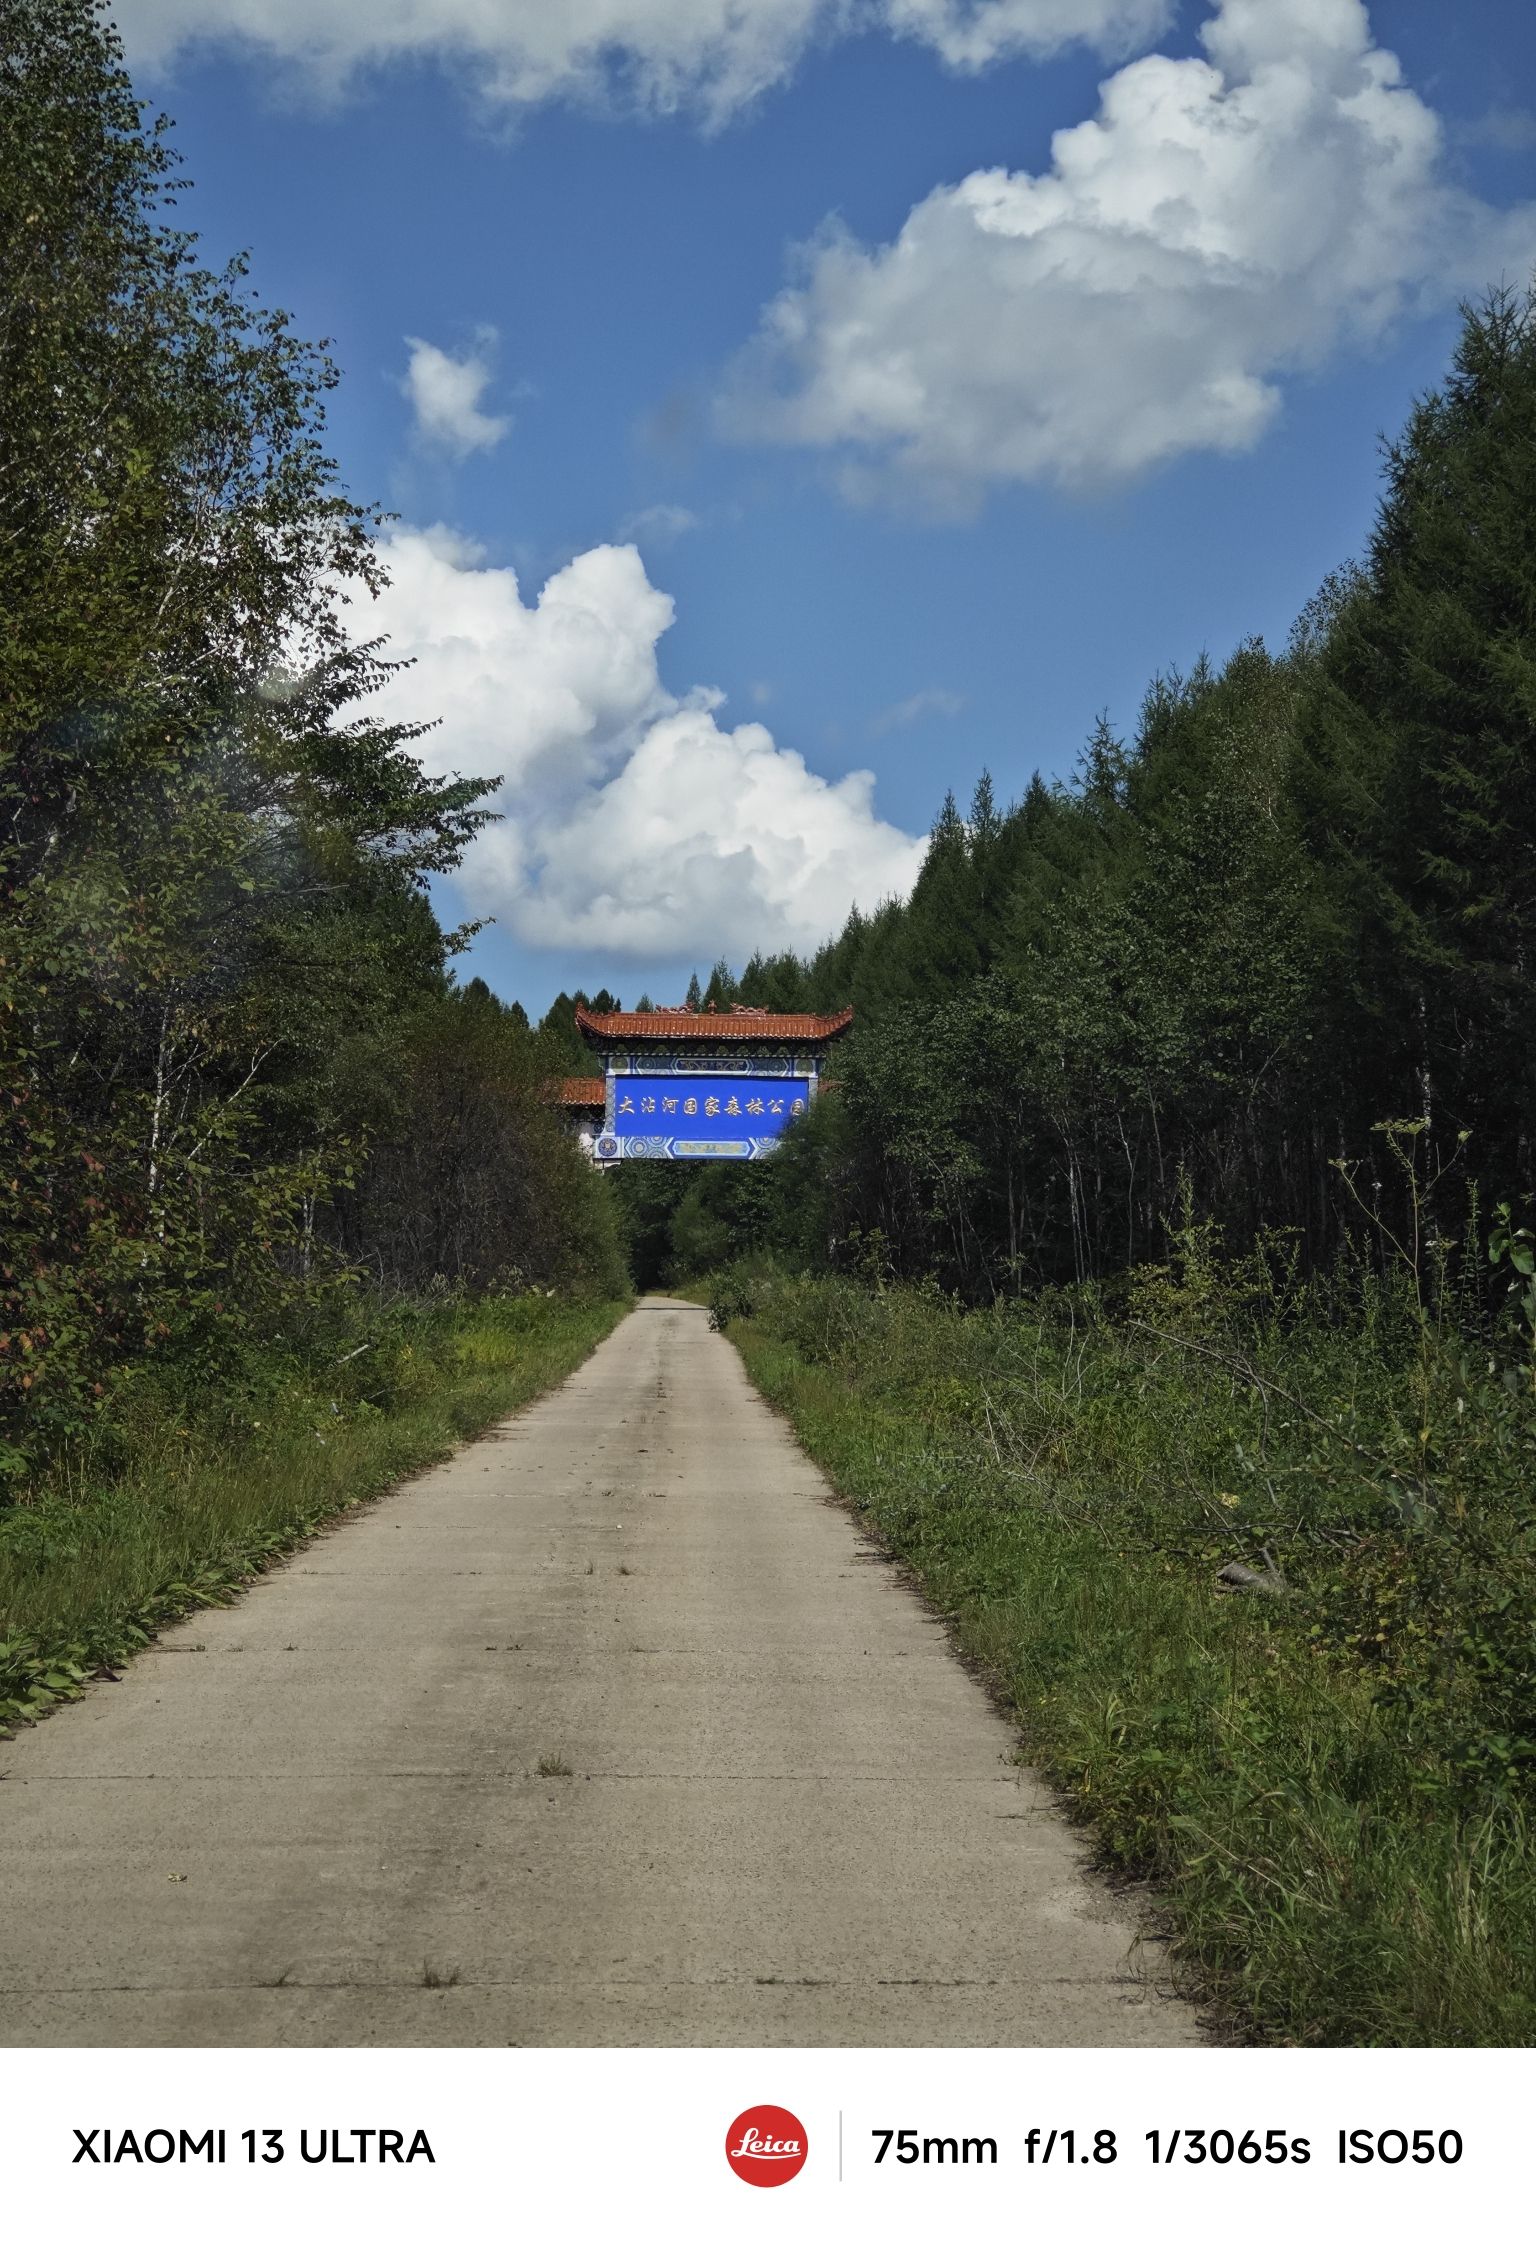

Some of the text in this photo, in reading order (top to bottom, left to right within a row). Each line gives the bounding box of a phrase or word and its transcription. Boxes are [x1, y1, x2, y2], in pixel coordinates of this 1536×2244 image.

[618, 1096, 805, 1116] 大沾河国家森林公园
